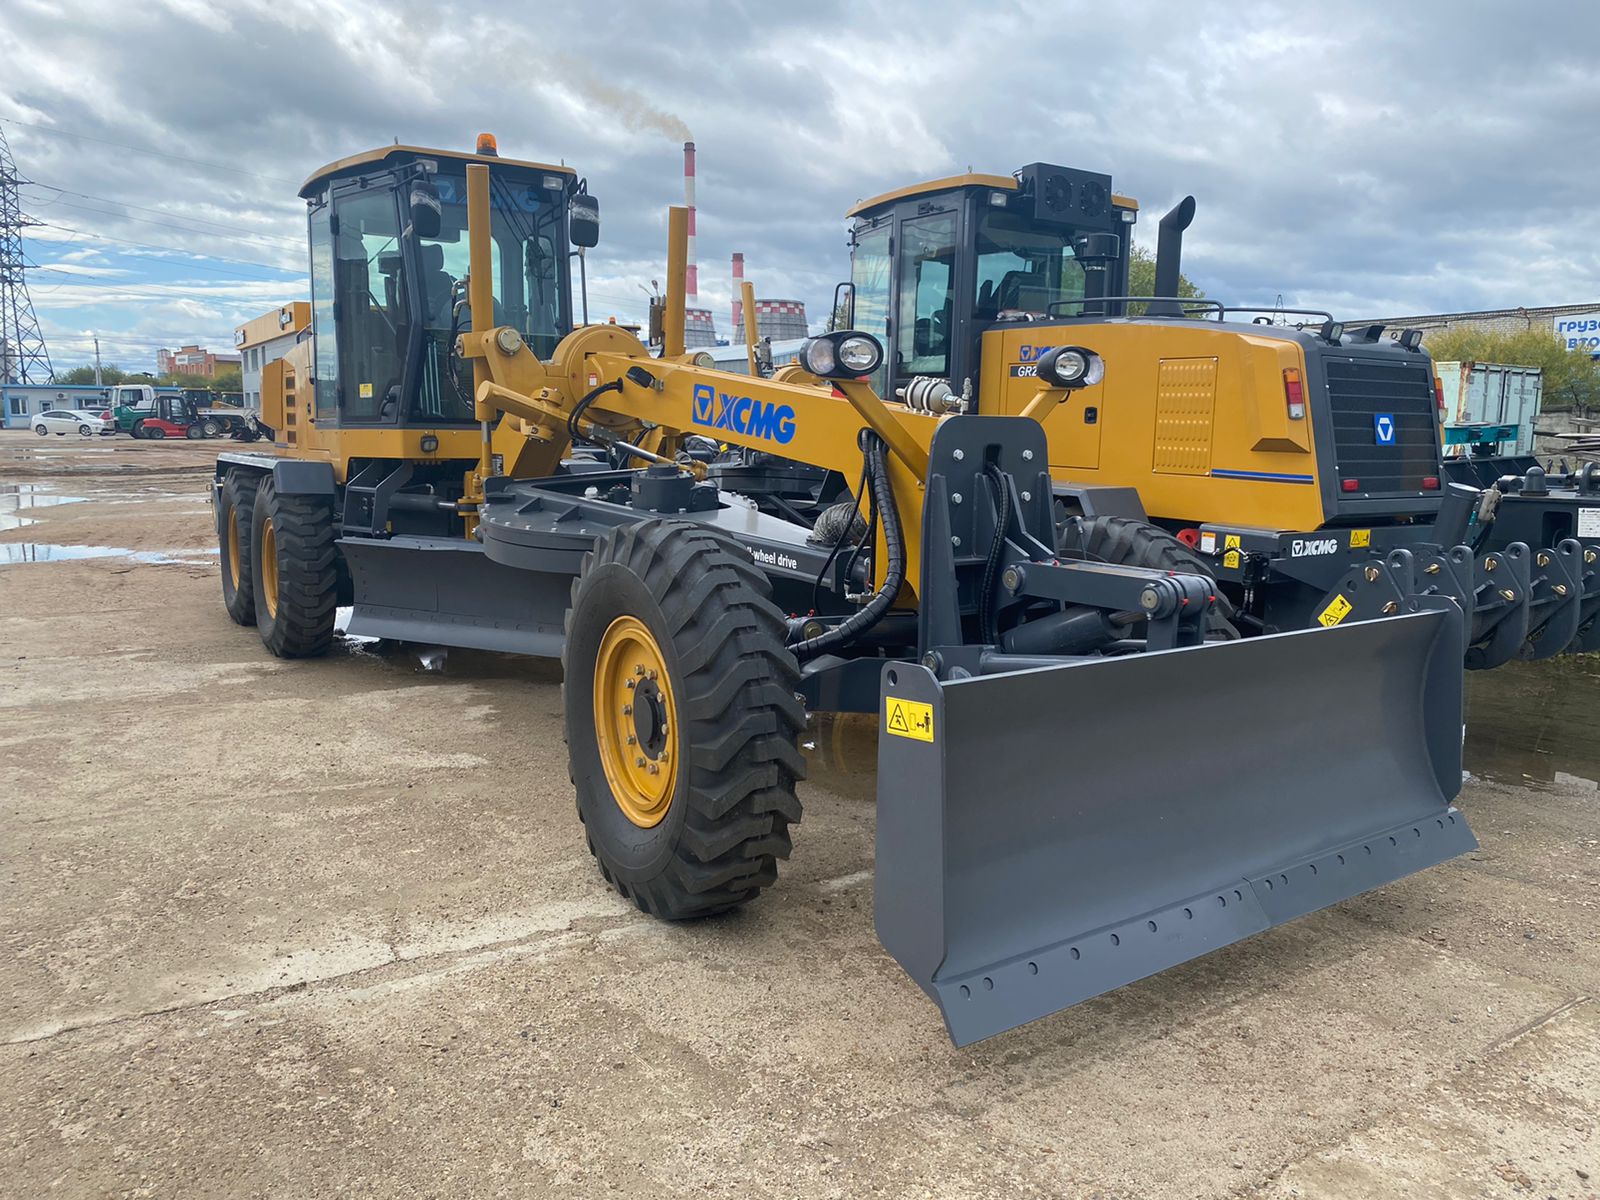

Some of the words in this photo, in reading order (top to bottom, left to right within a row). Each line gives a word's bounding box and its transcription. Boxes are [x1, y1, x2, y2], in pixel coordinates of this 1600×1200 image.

[1558, 320, 1600, 332] ГРУЗ
[1017, 365, 1038, 377] GR2
[714, 393, 796, 444] XCMG
[1303, 539, 1338, 556] XCMG
[777, 553, 798, 569] drive
